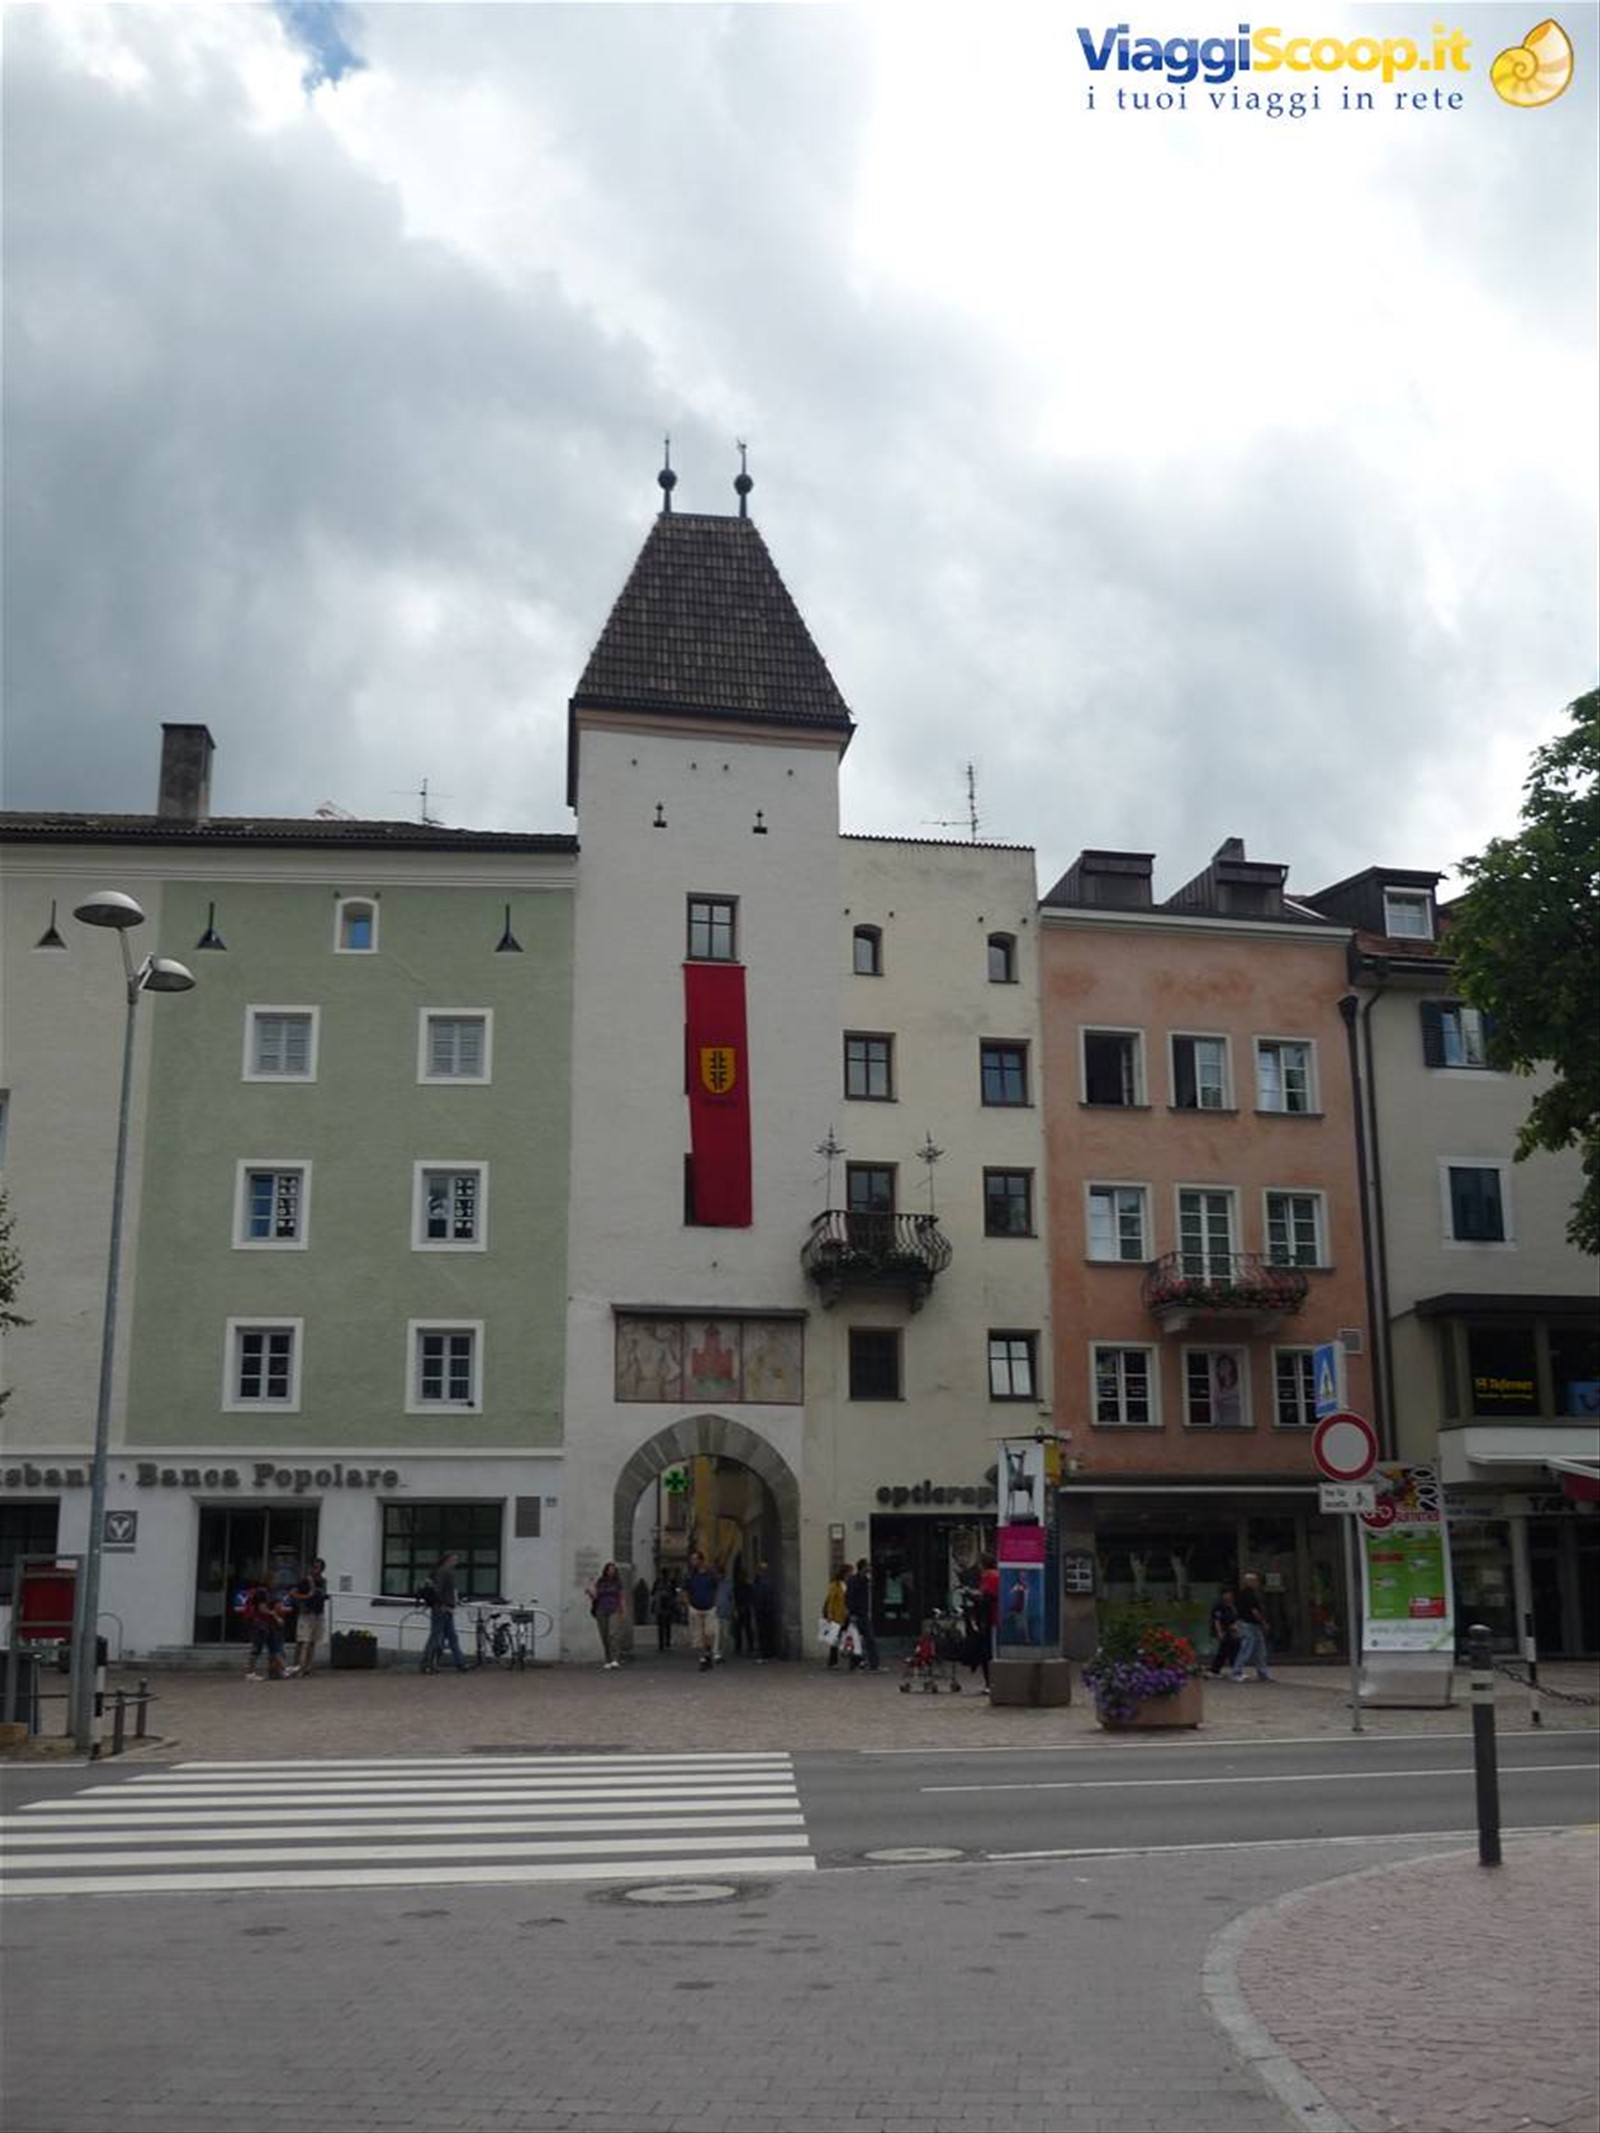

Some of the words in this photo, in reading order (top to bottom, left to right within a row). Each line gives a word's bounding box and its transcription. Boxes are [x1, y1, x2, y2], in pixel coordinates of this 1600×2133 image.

[0, 1463, 95, 1488] sban
[137, 1463, 238, 1488] Banca
[252, 1463, 398, 1493] Popolare
